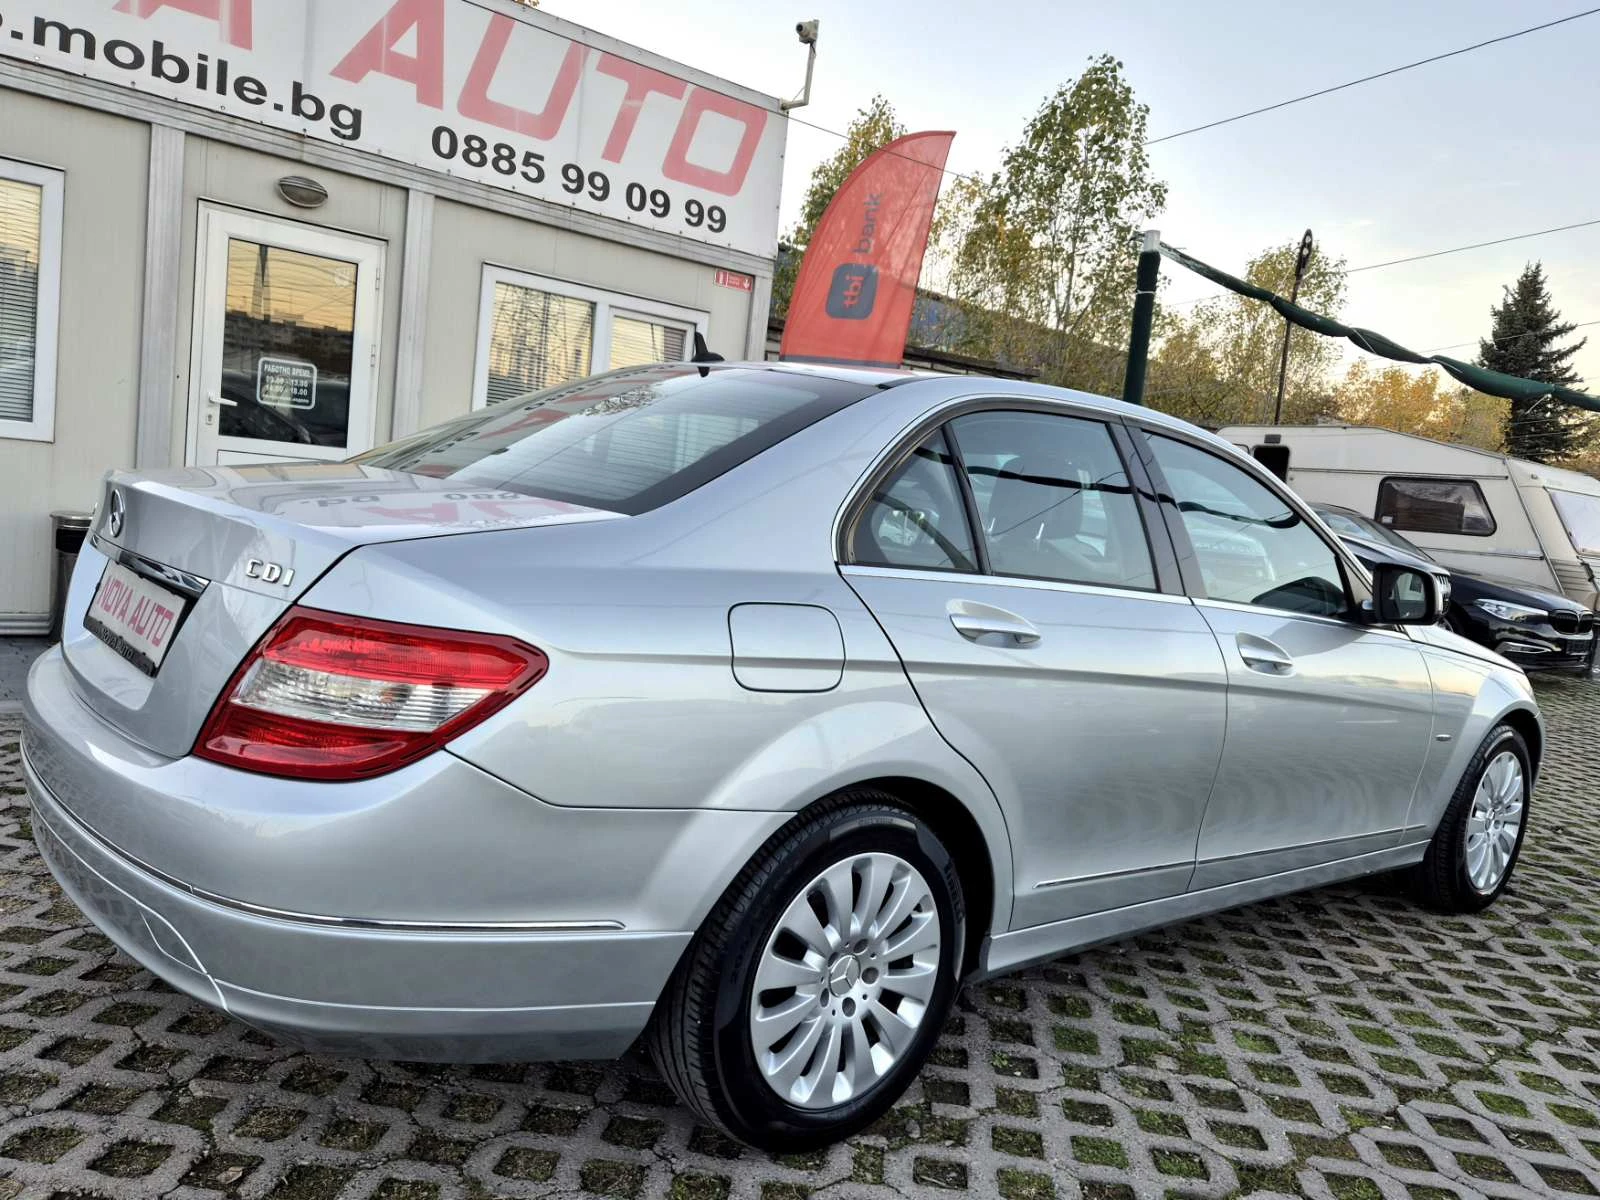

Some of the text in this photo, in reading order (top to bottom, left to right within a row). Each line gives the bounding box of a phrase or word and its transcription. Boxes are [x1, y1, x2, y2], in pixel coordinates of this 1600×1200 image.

[0, 12, 363, 141] .mobile.bg
[329, 0, 768, 197] AUTO
[432, 125, 727, 234] 0885 99 09 99
[851, 192, 884, 255] bank
[97, 575, 175, 648] NOVA AUTO
[246, 558, 296, 588] CDI
